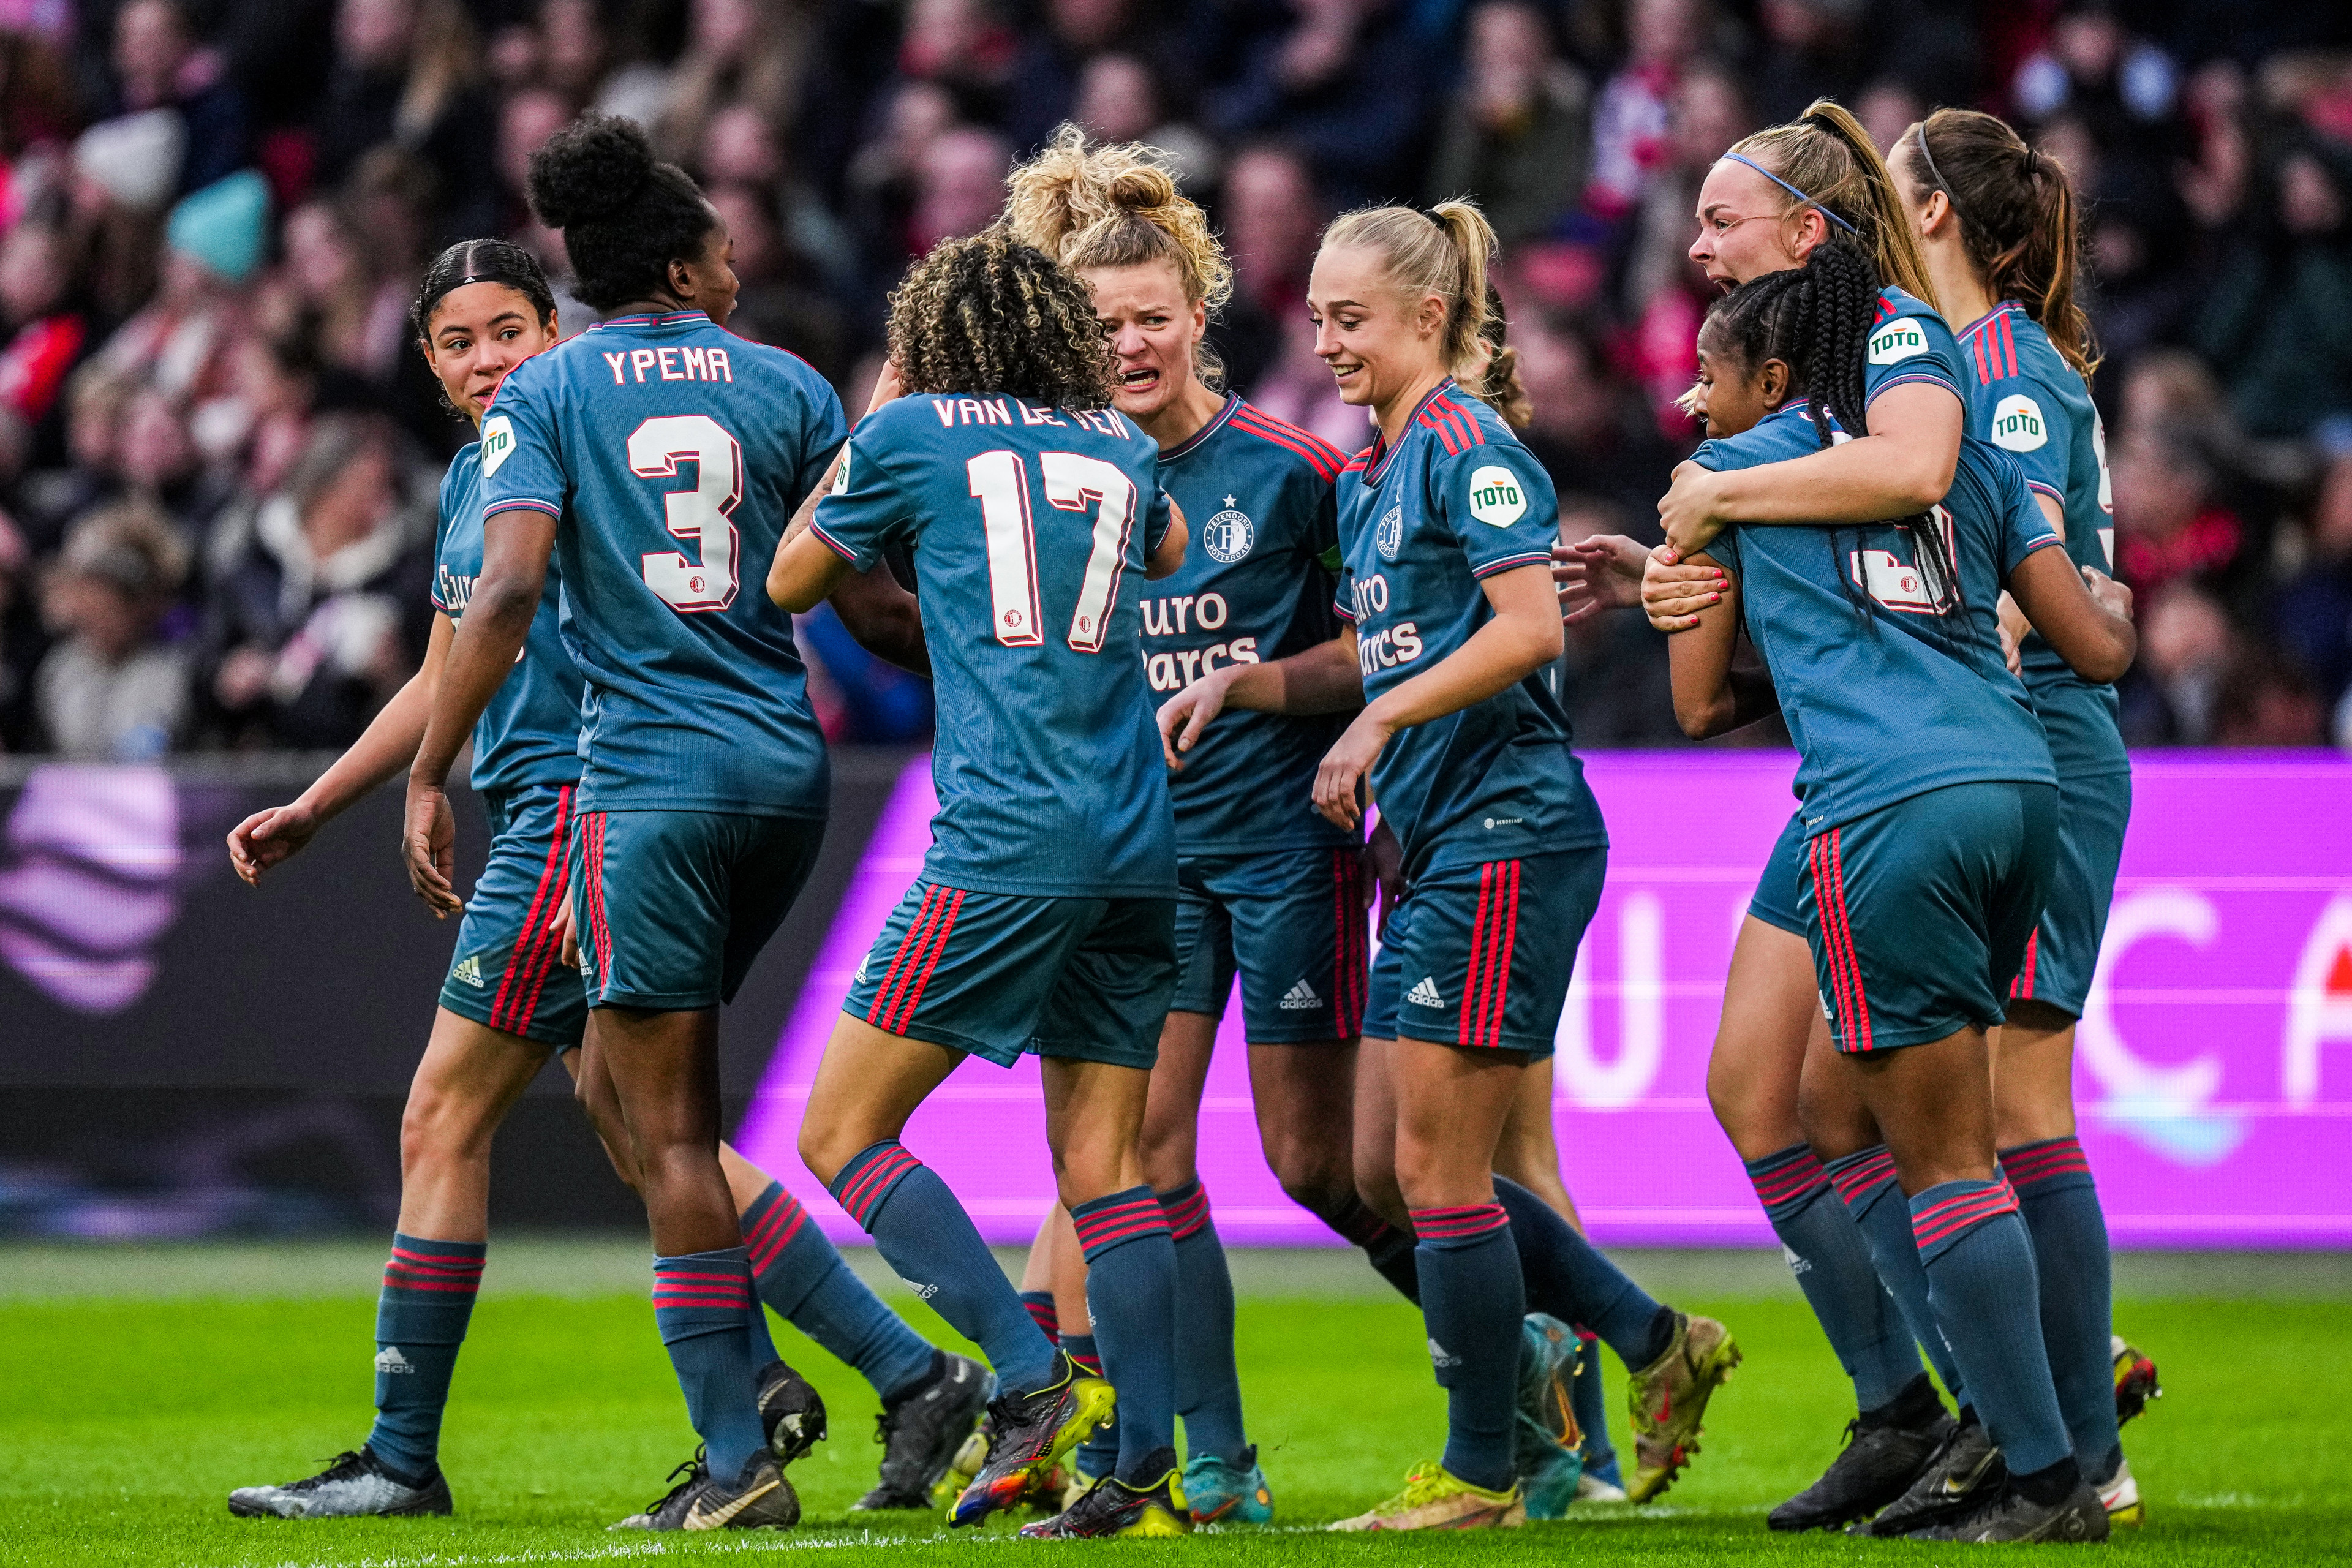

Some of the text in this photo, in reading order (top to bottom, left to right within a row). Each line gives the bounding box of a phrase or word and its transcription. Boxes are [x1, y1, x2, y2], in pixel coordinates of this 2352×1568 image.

[1872, 332, 1919, 355] TOTO
[602, 347, 733, 385] YPEMA
[932, 398, 1012, 428] VAN
[1996, 414, 2039, 437] TOTO
[1472, 486, 1518, 510] TOTO
[627, 414, 744, 612] 3
[1208, 512, 1251, 531] FEYENOORD
[966, 450, 1137, 654] 17
[1208, 542, 1251, 562] ROTTERDAM
[1139, 592, 1227, 636] uro
[1141, 637, 1261, 692] arcs
[453, 968, 484, 988] adidas
[1280, 997, 1323, 1010] adidas
[1408, 993, 1444, 1009] adidas
